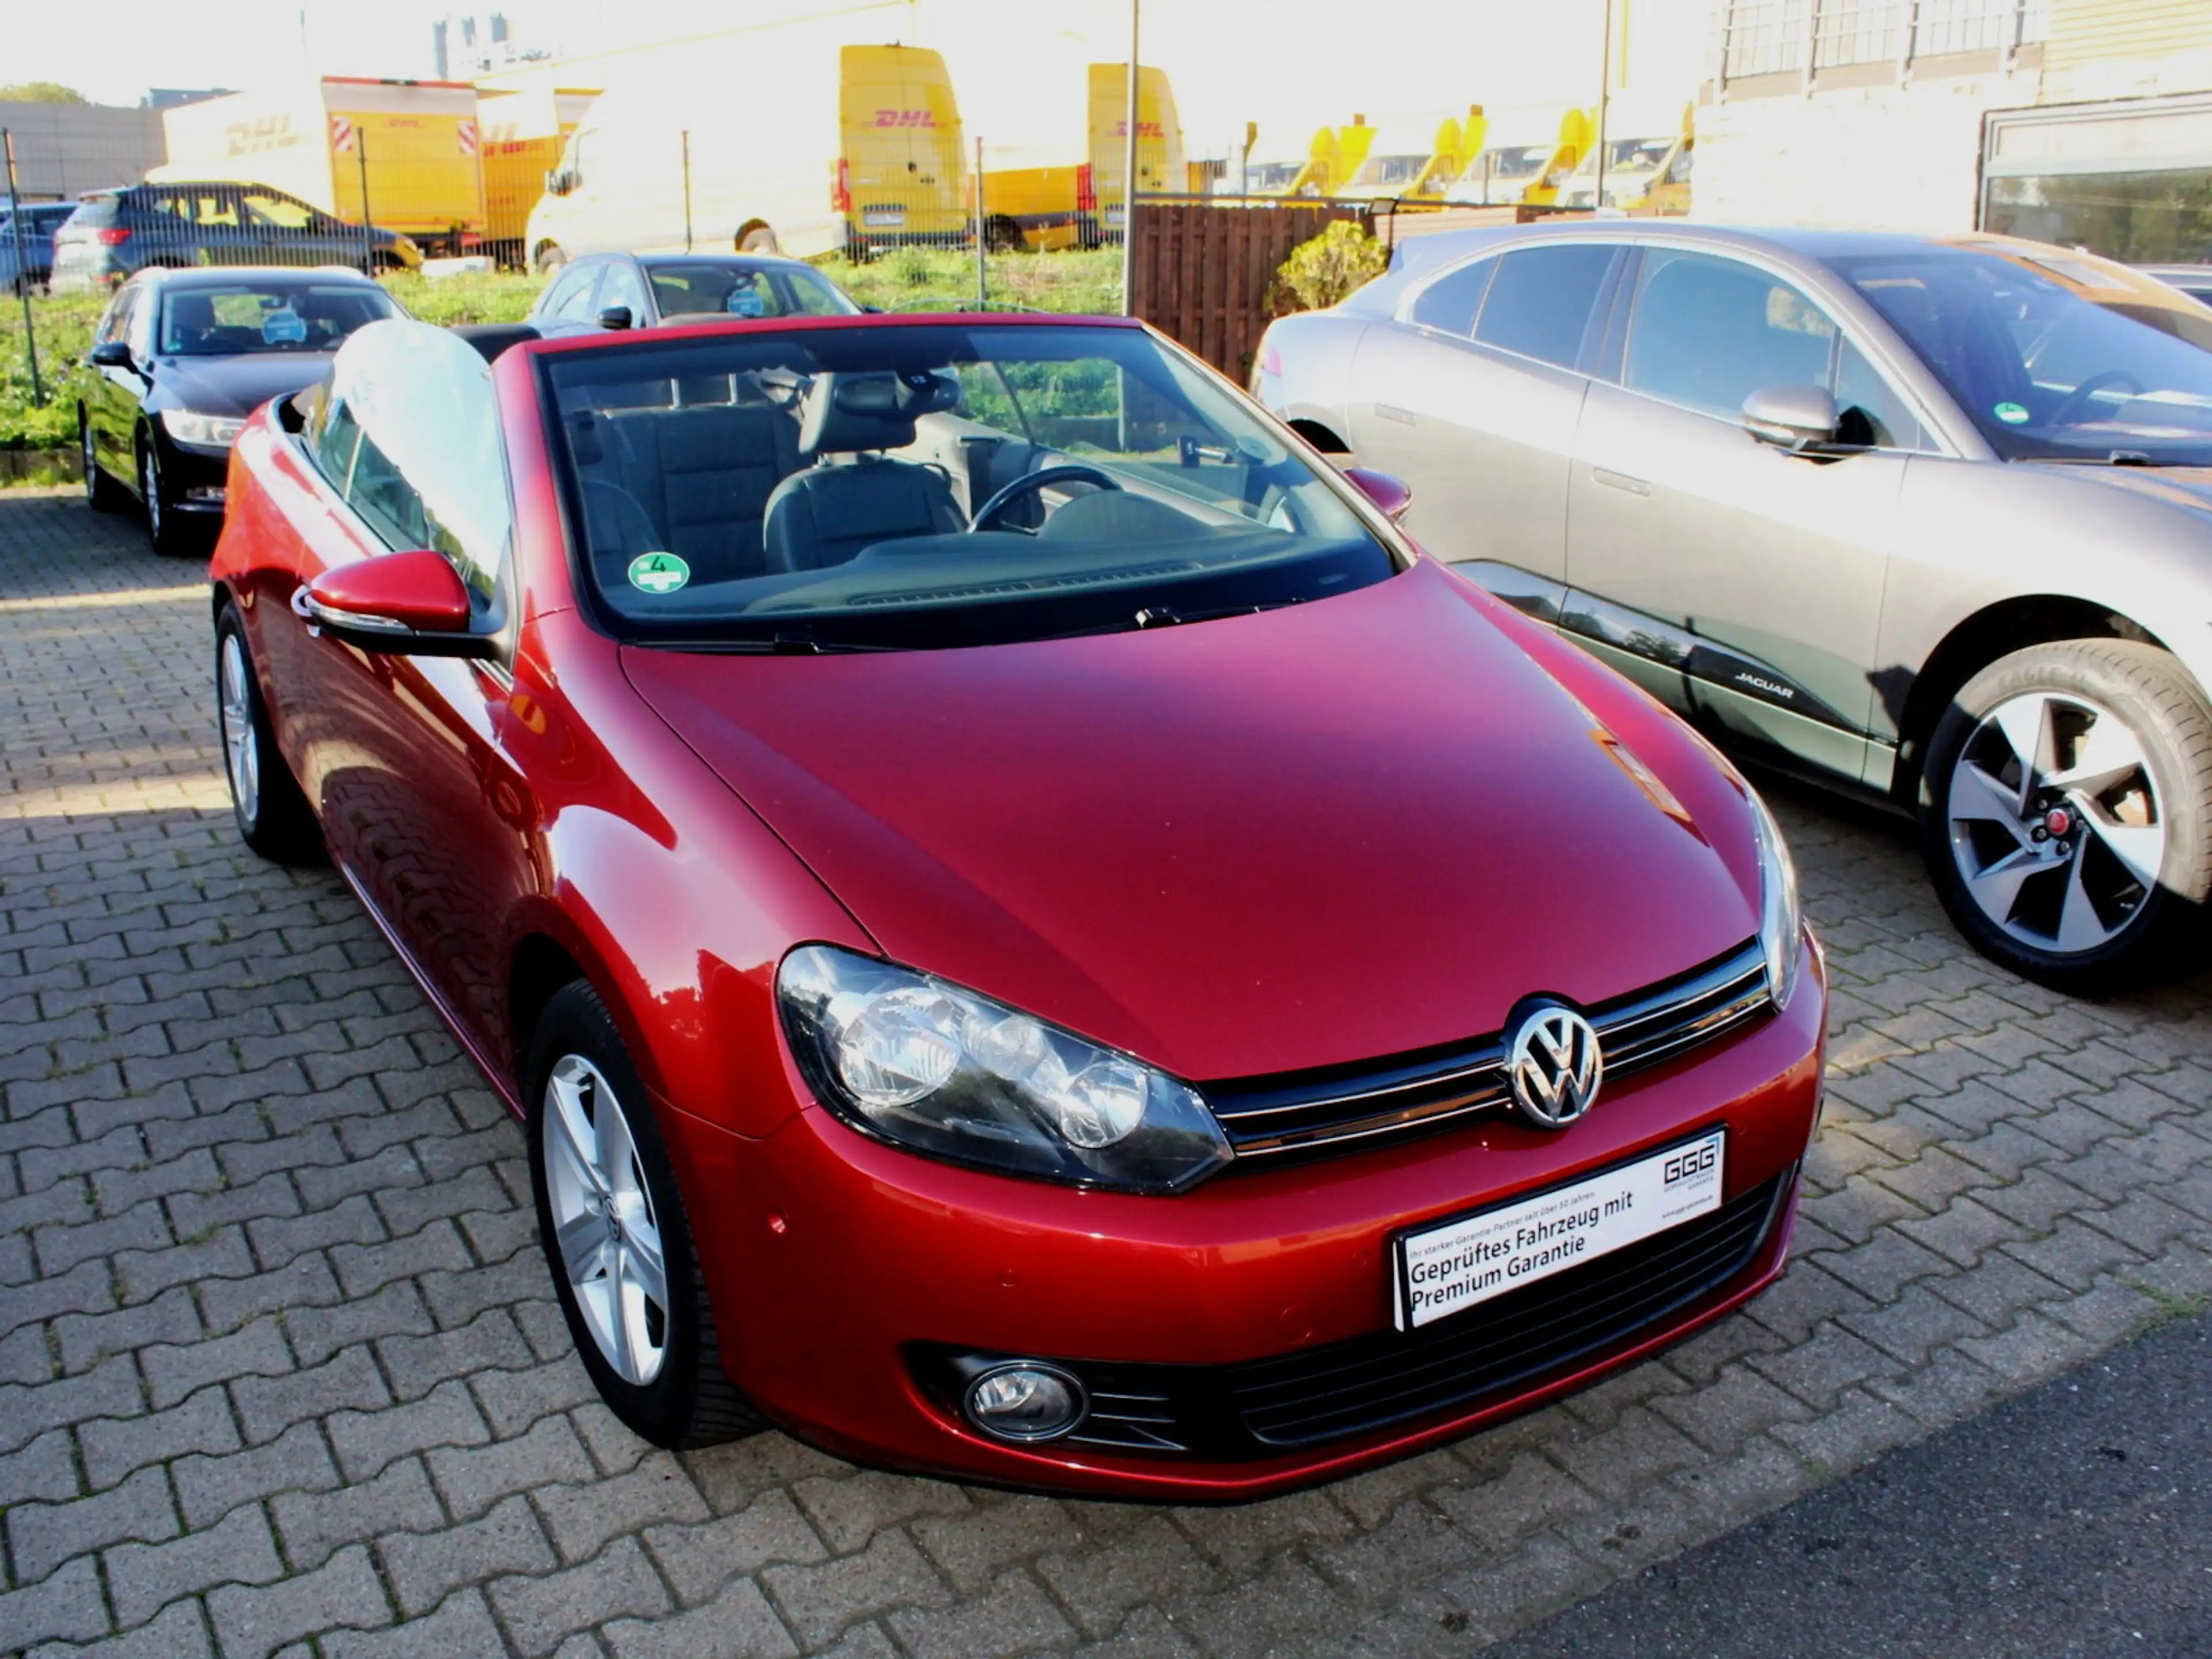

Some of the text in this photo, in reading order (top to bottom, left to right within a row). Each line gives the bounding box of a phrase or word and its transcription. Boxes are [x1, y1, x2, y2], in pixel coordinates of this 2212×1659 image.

[225, 113, 299, 156] DHL
[875, 110, 935, 127] DHL
[650, 555, 666, 572] 4
[1735, 673, 1794, 699] JAGUAR
[1664, 1144, 1715, 1184] GGG
[1410, 1192, 1595, 1260] Ihr starker Garantie-Partner seit über 50 Jahren
[1411, 1191, 1633, 1284] Geprüftes Fahrzeug mit
[1412, 1235, 1585, 1312] Premium Garantie
